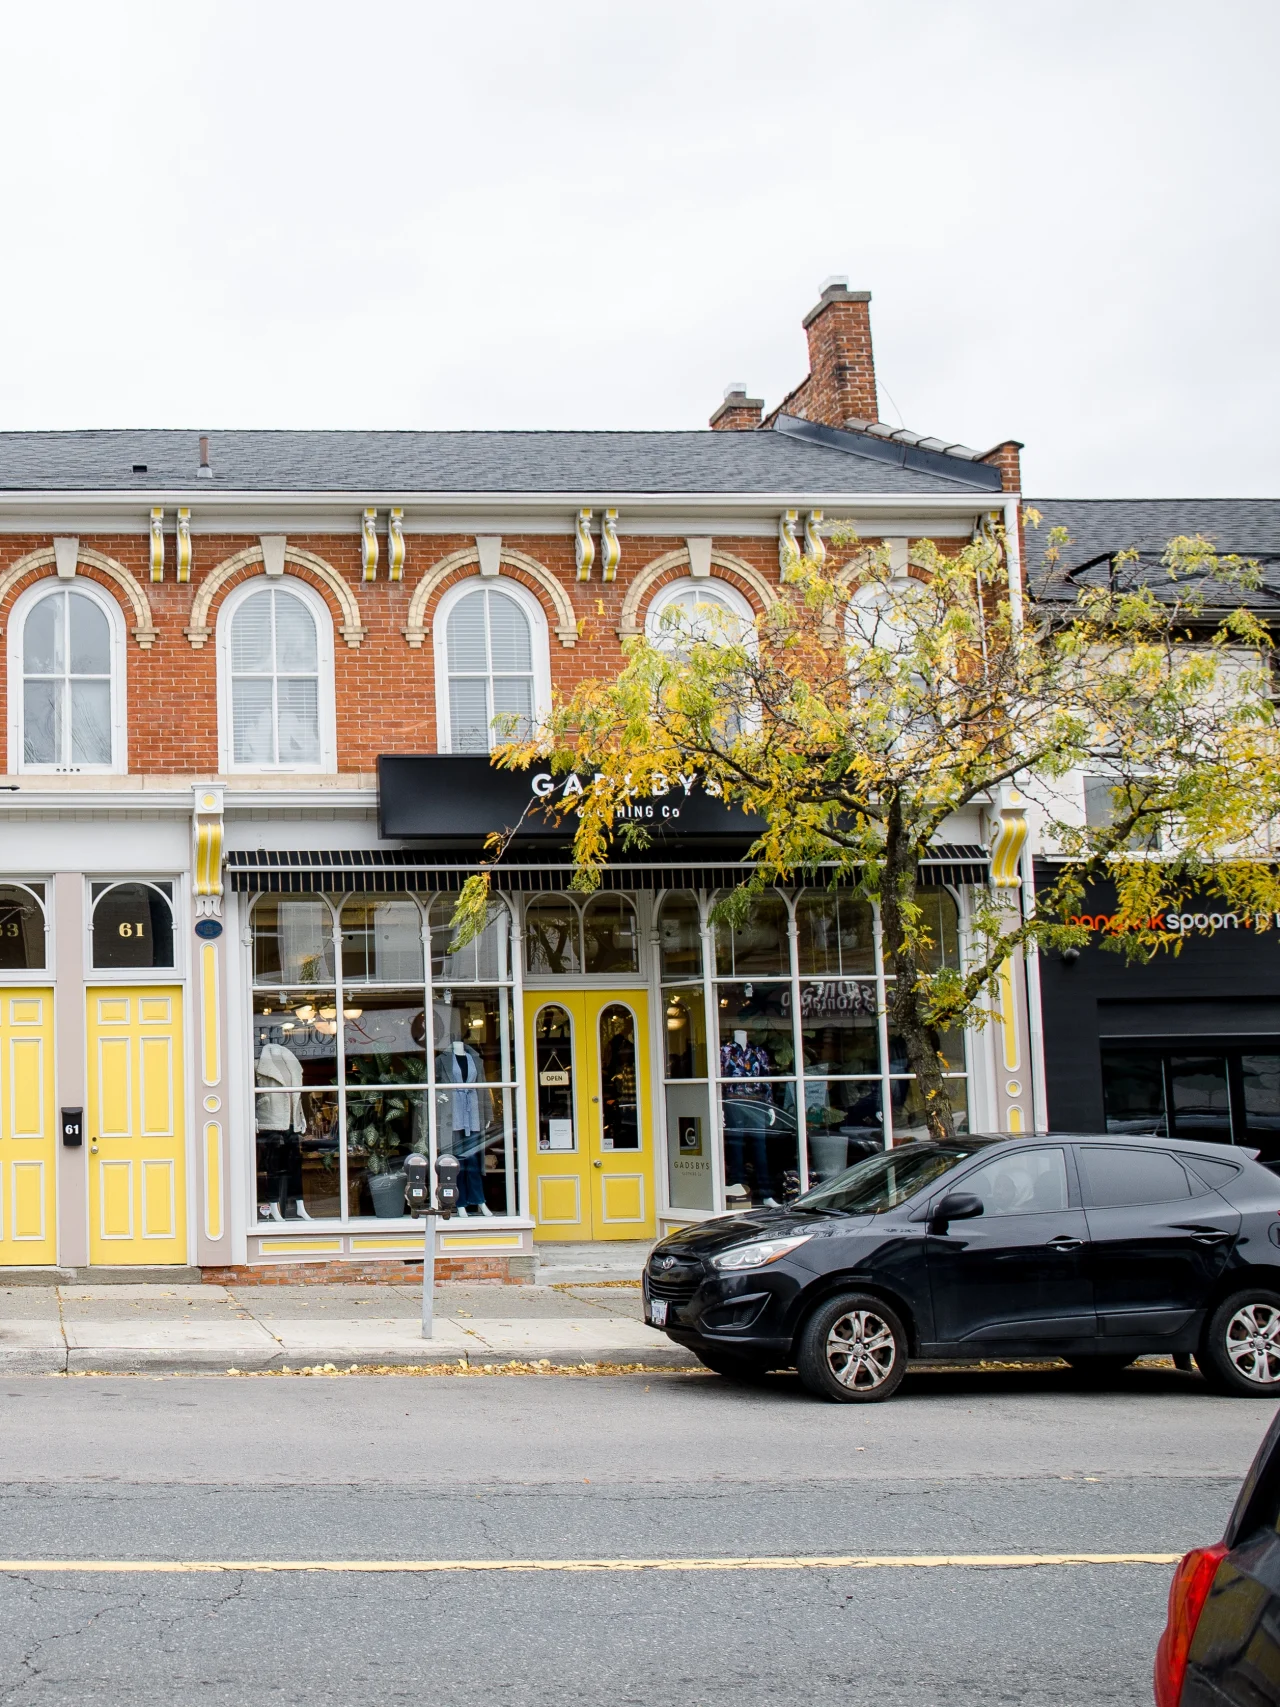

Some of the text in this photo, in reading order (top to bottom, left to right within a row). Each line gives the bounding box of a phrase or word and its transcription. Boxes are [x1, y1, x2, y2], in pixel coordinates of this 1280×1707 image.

[577, 805, 680, 818] COHING Co
[1065, 908, 1166, 936] bangk
[1166, 913, 1238, 936] spoon
[119, 922, 145, 937] 61
[65, 1124, 79, 1135] 61
[685, 1127, 696, 1145] G
[674, 1161, 710, 1170] GADSBYS
